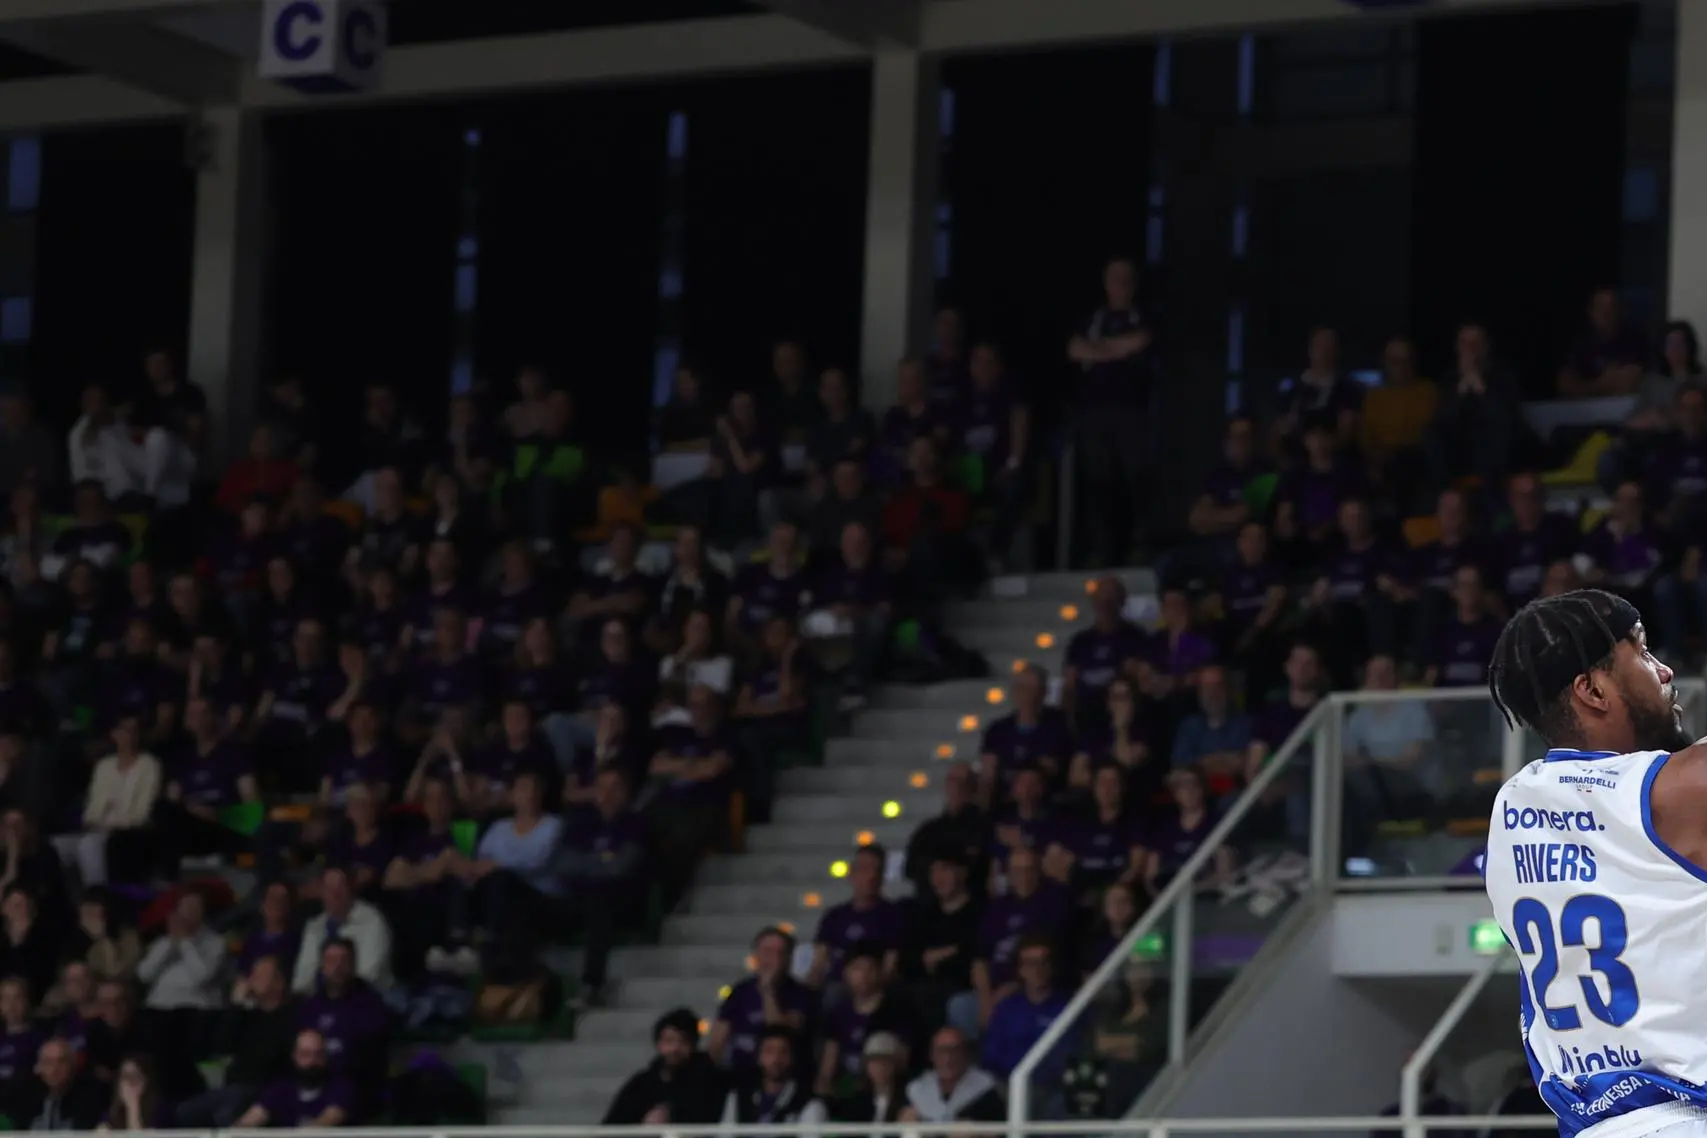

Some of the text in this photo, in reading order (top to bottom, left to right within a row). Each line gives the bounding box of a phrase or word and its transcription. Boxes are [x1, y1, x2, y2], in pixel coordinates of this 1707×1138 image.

[273, 1, 324, 60] C
[1559, 776, 1616, 789] BERNARDELLI
[1504, 800, 1605, 832] bonera.
[1512, 843, 1597, 883] RIVERS
[1512, 893, 1640, 1031] 23
